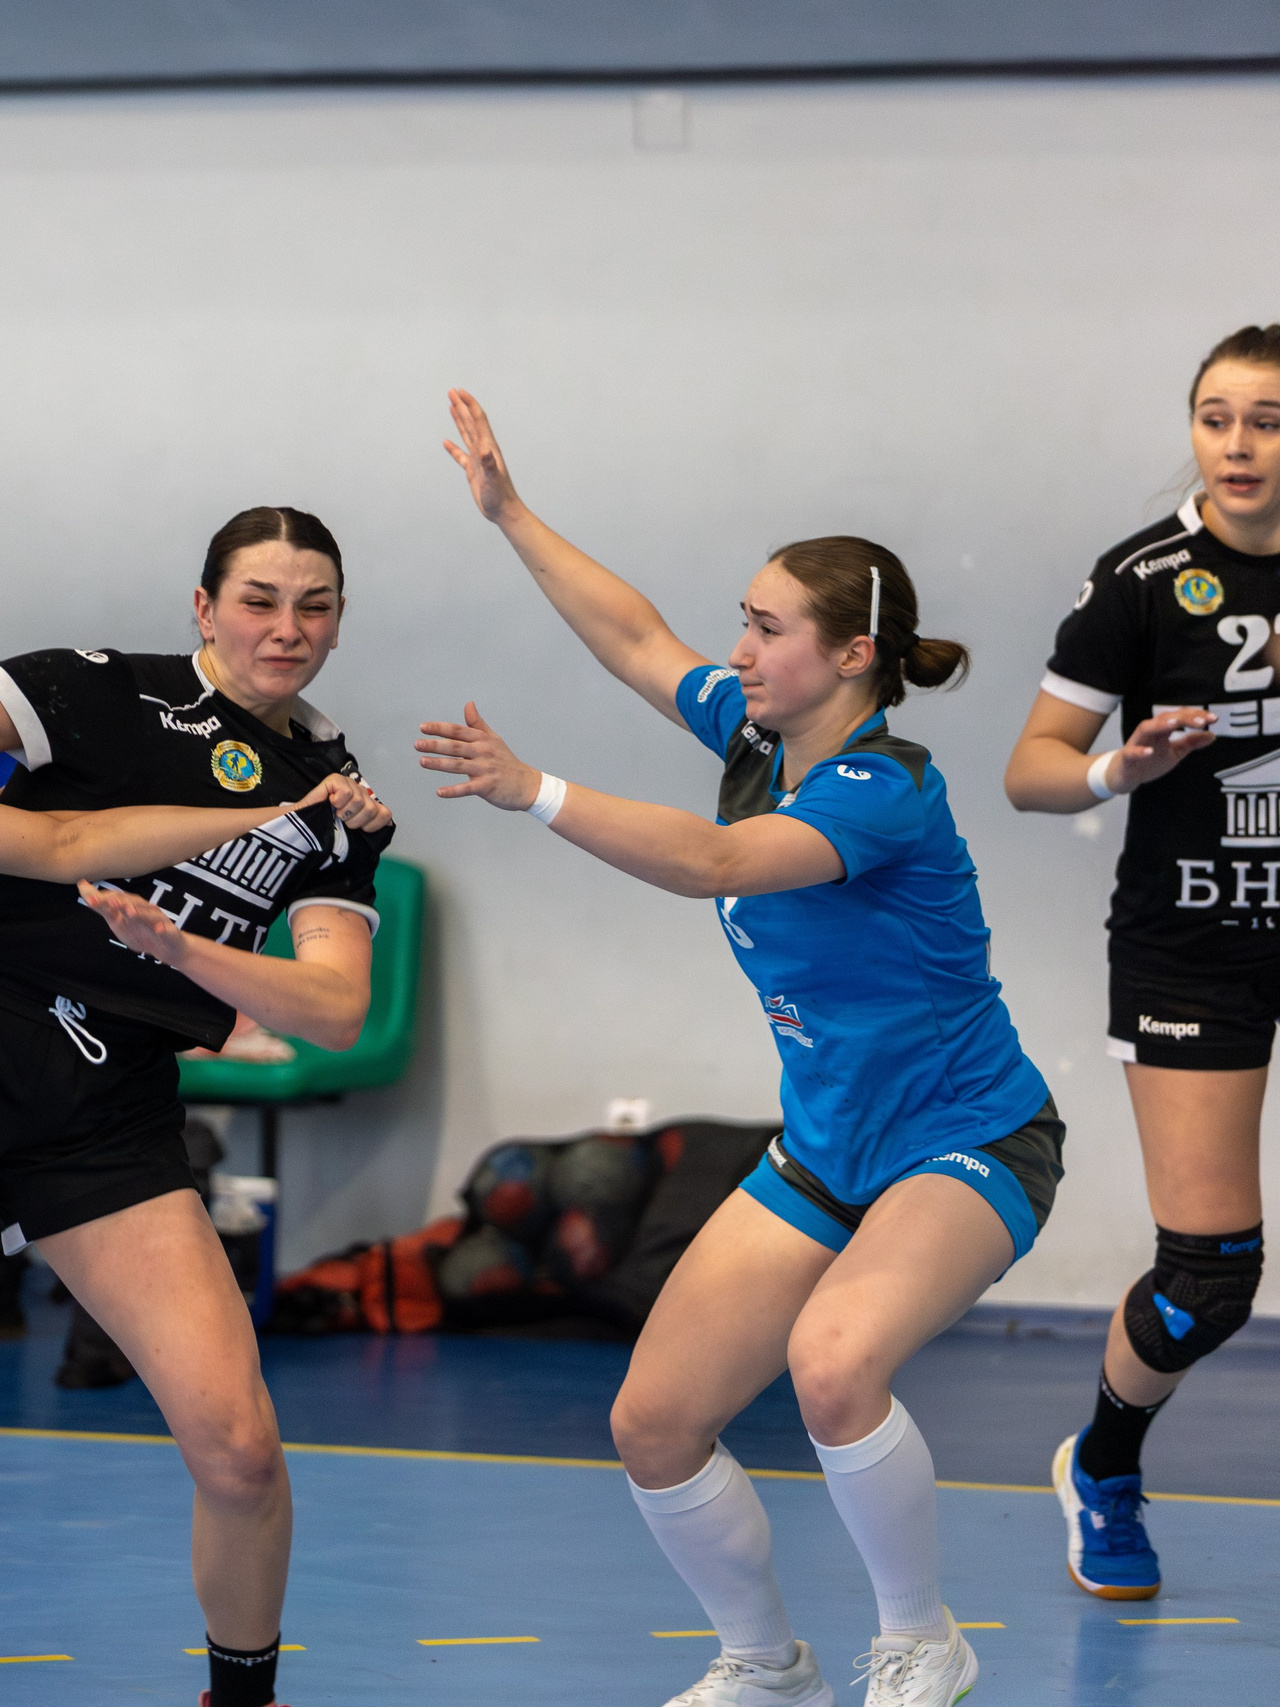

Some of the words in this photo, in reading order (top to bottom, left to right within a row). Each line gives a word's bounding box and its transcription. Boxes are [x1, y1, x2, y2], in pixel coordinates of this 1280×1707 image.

[1132, 548, 1192, 580] Kempa
[1217, 614, 1280, 693] 2
[159, 711, 222, 739] Kempa
[1138, 1014, 1200, 1041] Kempa
[925, 1152, 990, 1178] mpa
